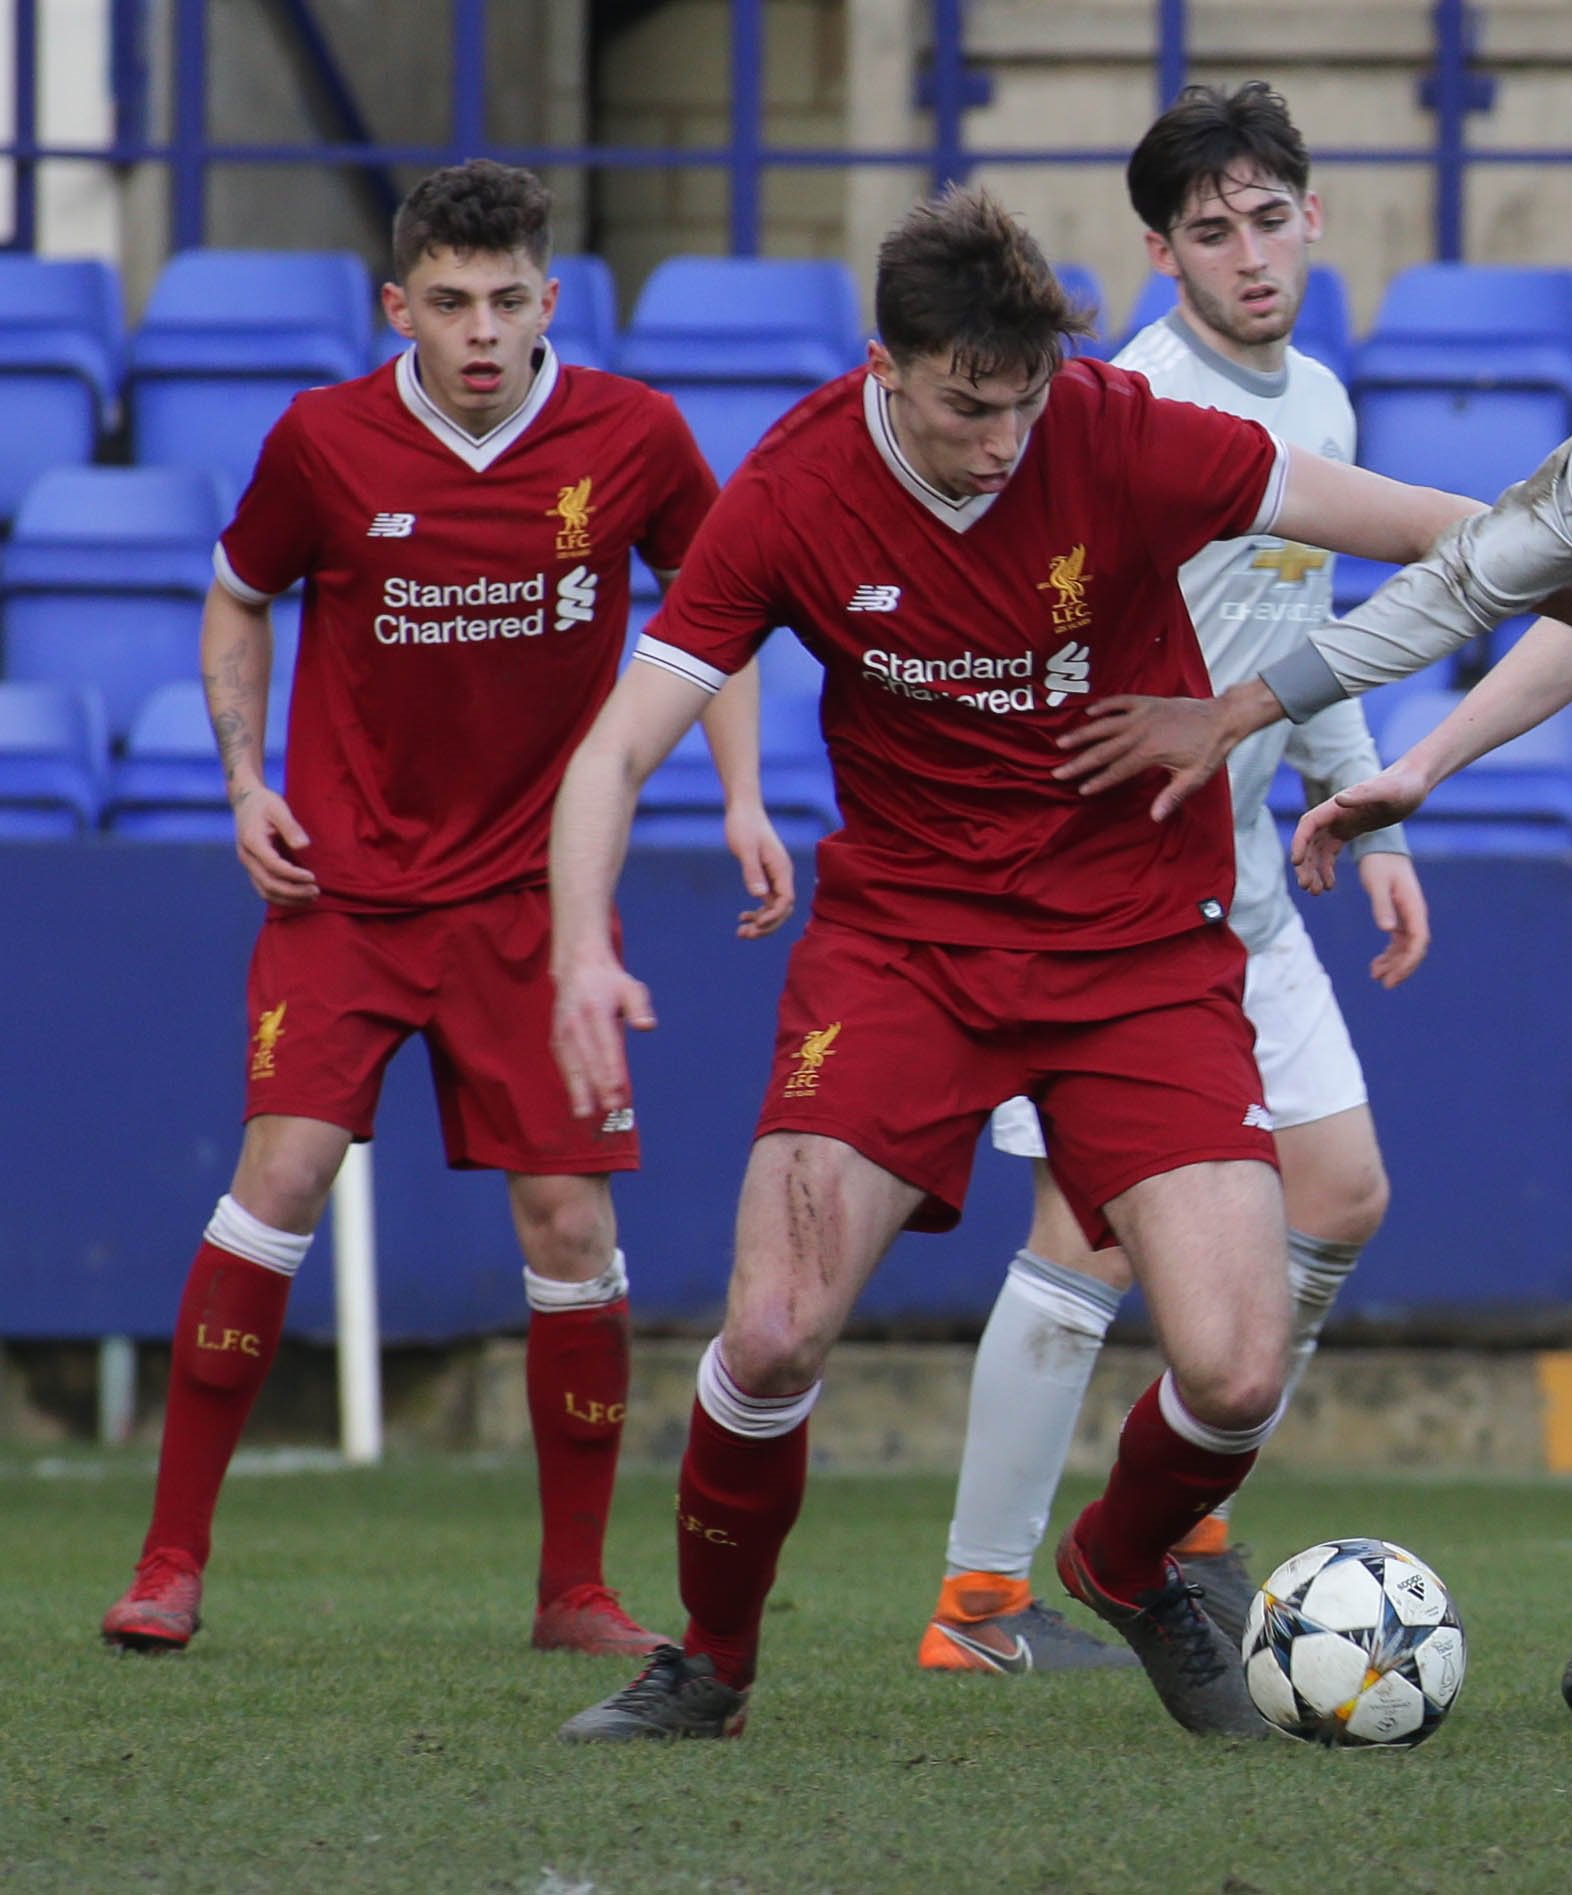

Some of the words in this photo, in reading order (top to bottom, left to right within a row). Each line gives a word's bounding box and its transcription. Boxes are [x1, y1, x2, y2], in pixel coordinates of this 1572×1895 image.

[556, 535, 591, 549] LFC
[384, 573, 545, 608] Standard
[374, 608, 545, 645] Chartered
[1051, 602, 1093, 624] LFC
[863, 650, 1033, 684] Standard
